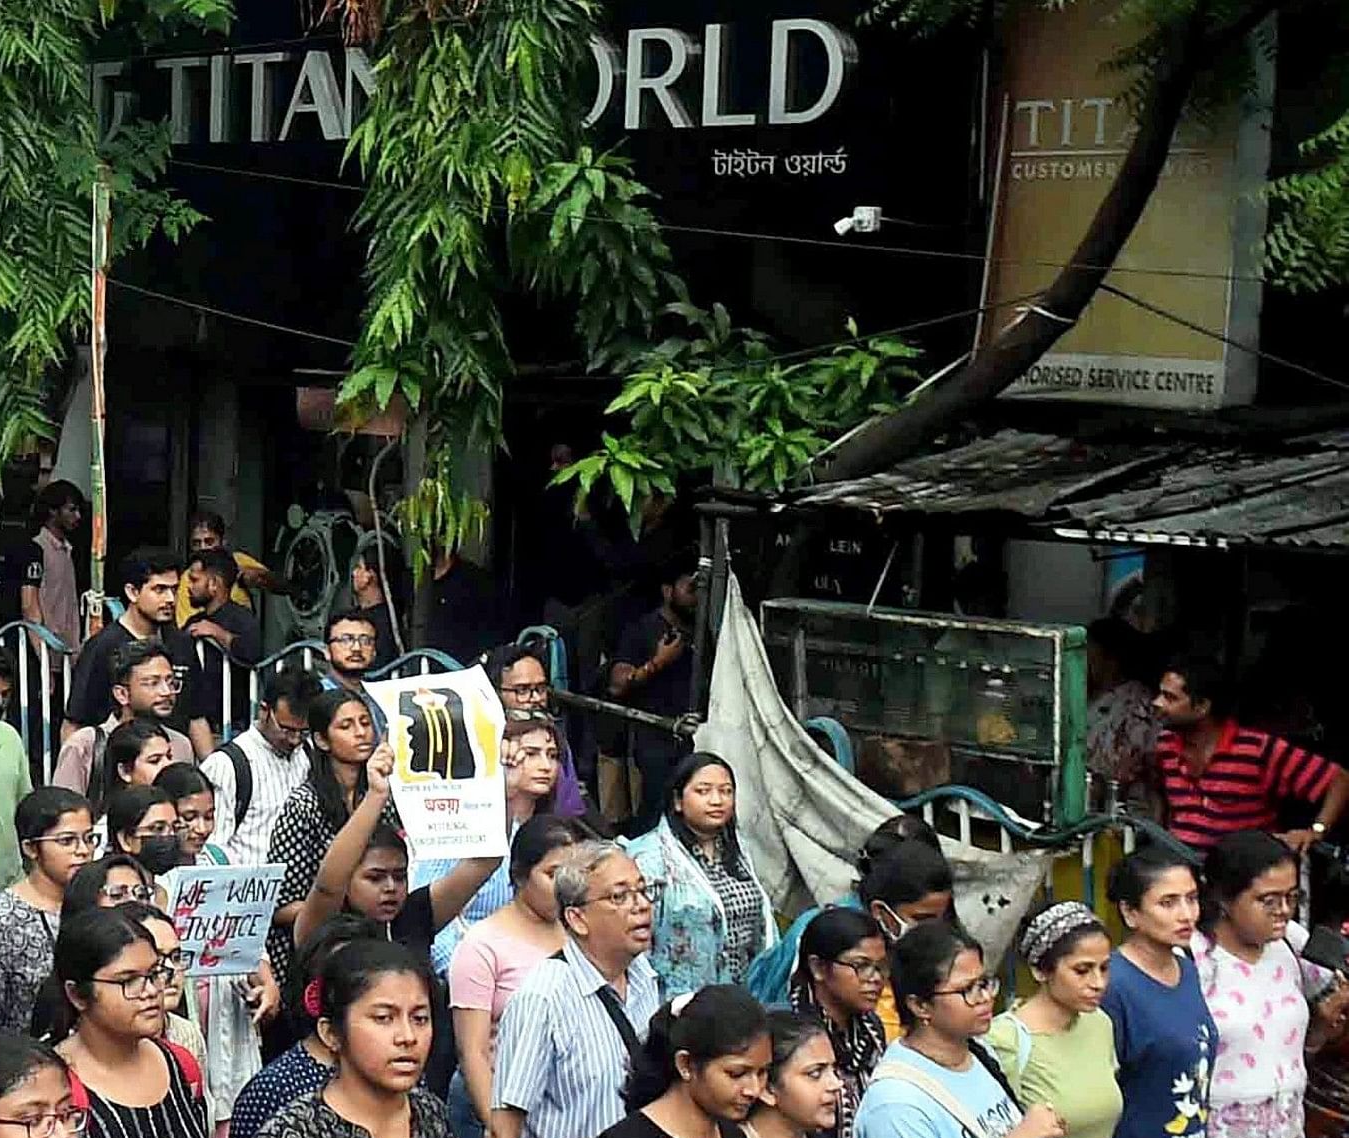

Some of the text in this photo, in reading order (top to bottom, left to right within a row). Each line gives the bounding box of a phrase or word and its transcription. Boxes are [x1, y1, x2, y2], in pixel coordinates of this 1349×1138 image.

[711, 146, 849, 177] টাইটন ওয়ার্ল্ড
[1088, 365, 1150, 391] SERVICE
[1156, 371, 1215, 395] CENTRE
[175, 877, 284, 908] WE WANT
[181, 911, 264, 942] JUSTICE
